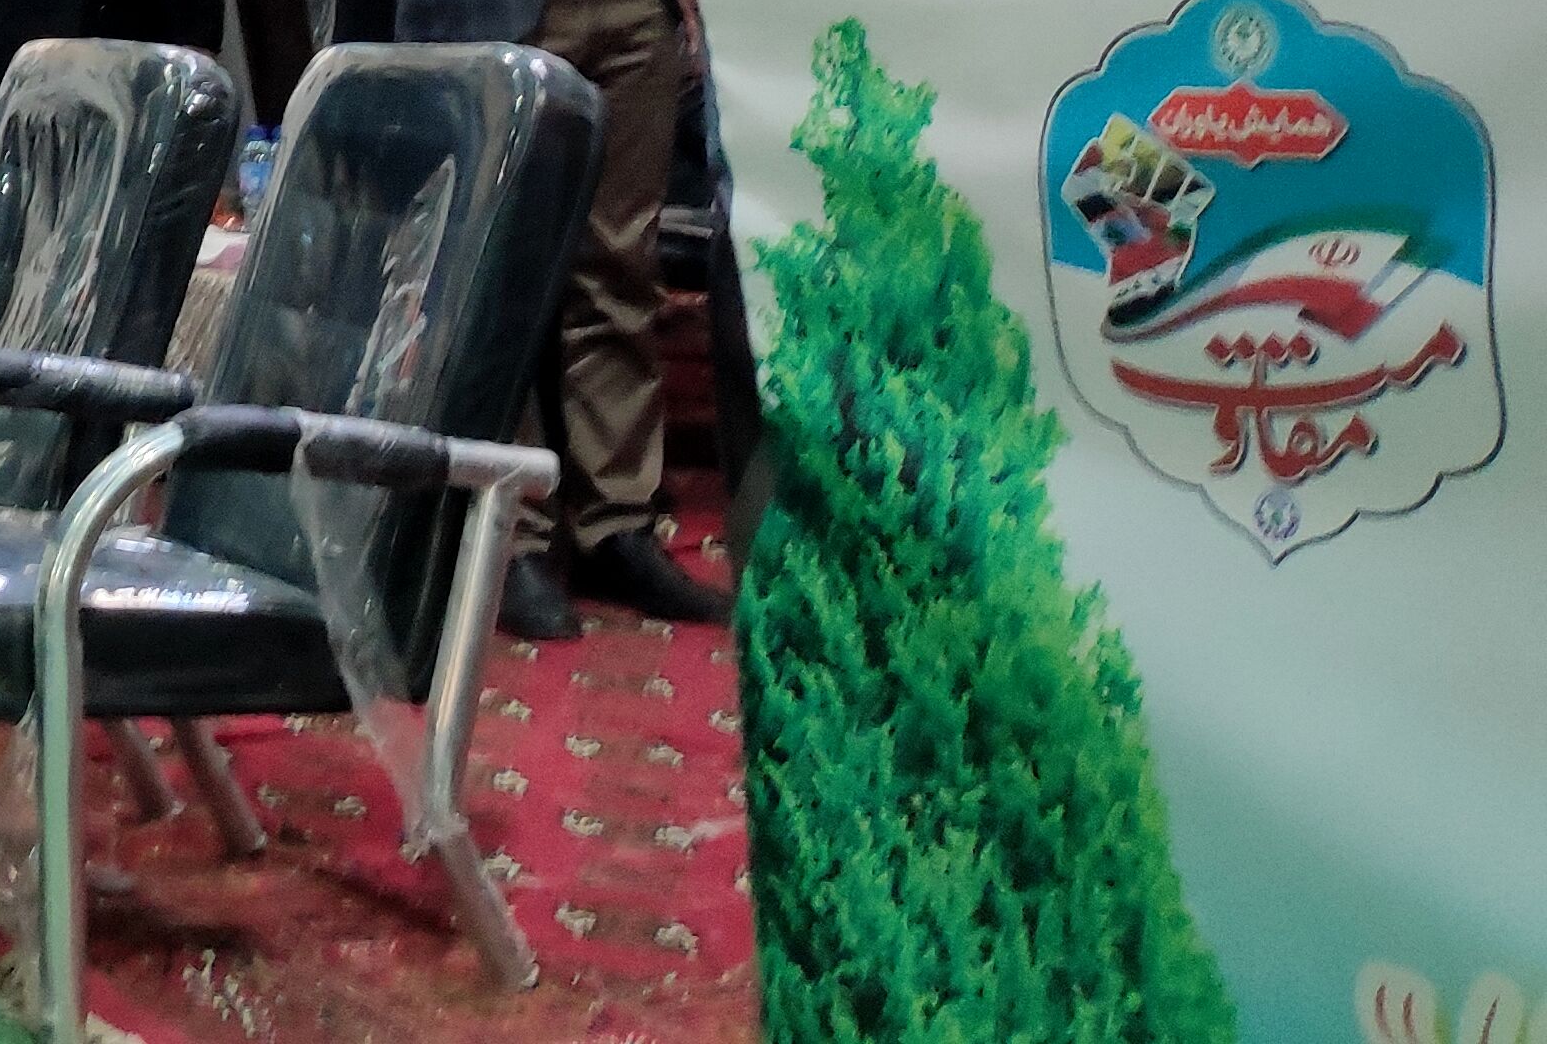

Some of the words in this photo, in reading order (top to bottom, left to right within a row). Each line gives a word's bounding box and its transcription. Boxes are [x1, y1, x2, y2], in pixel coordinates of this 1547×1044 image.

[1159, 101, 1228, 143] یاوران
[1228, 102, 1332, 143] همایش
[1111, 319, 1463, 481] مقاومت
